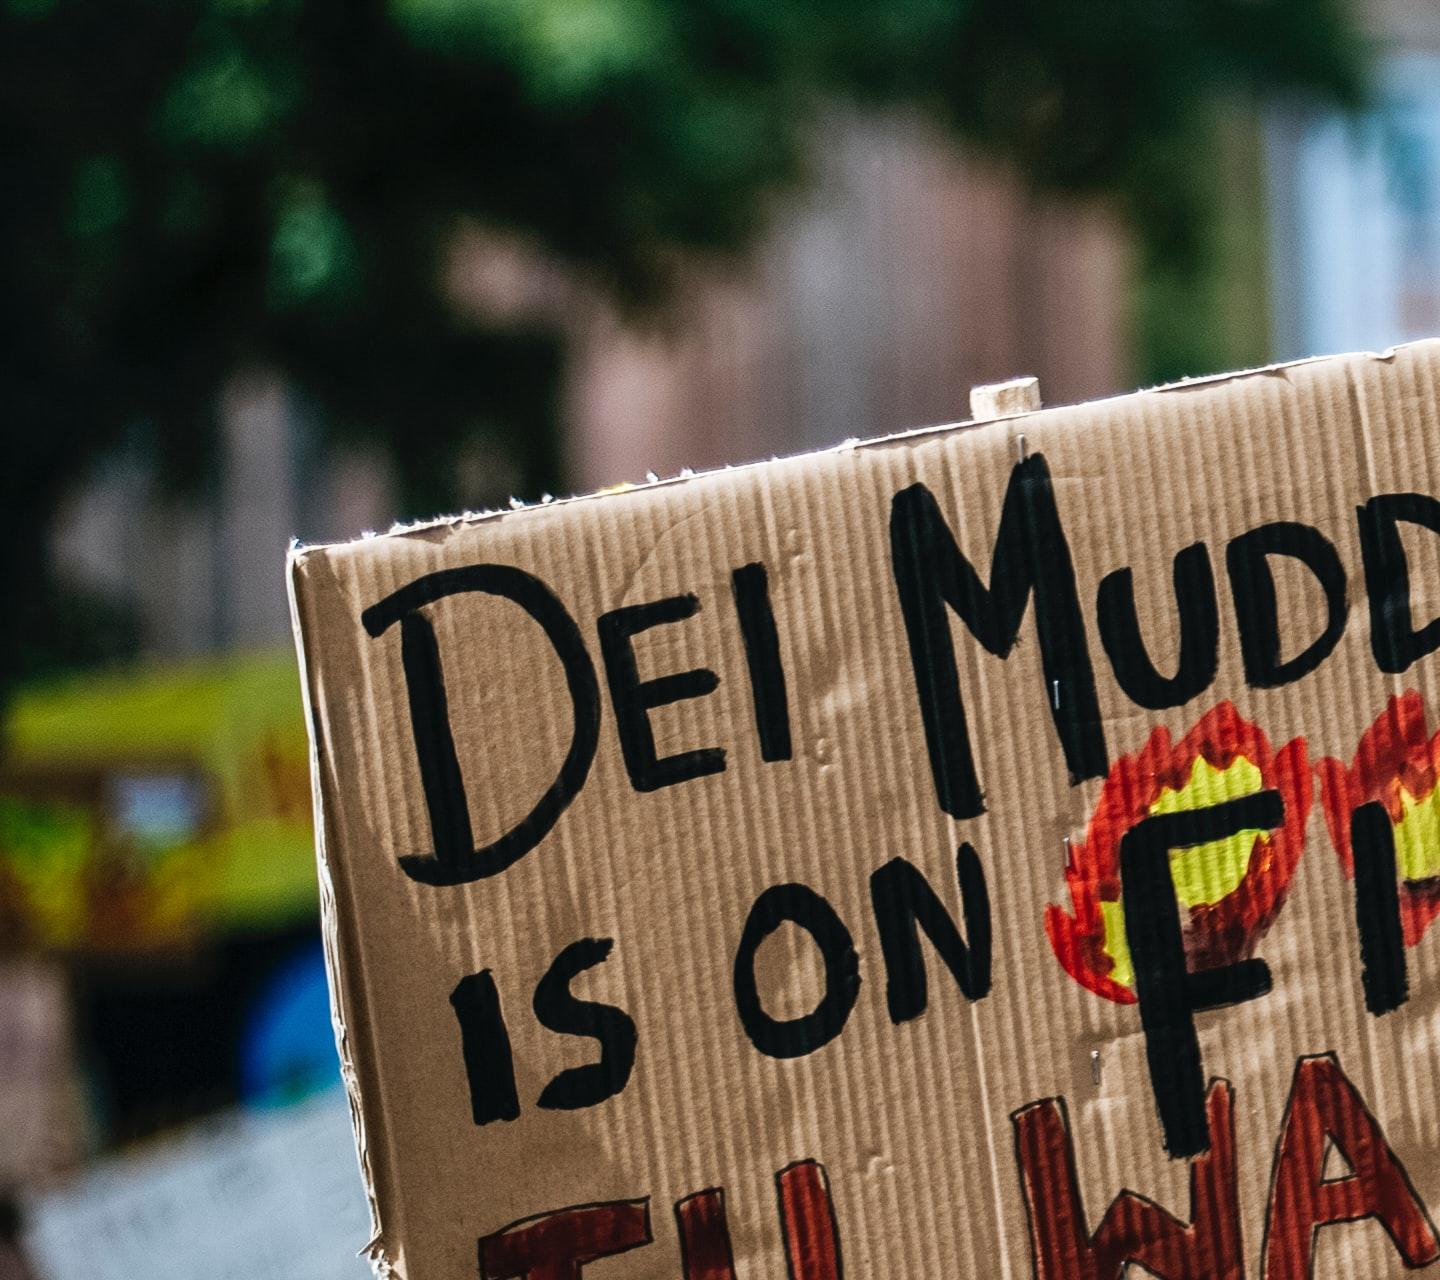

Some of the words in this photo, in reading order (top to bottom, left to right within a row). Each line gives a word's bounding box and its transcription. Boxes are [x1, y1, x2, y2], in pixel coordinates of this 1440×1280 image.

[362, 563, 791, 886] DEI
[450, 938, 637, 1125] IS
[733, 841, 994, 1059] ON
